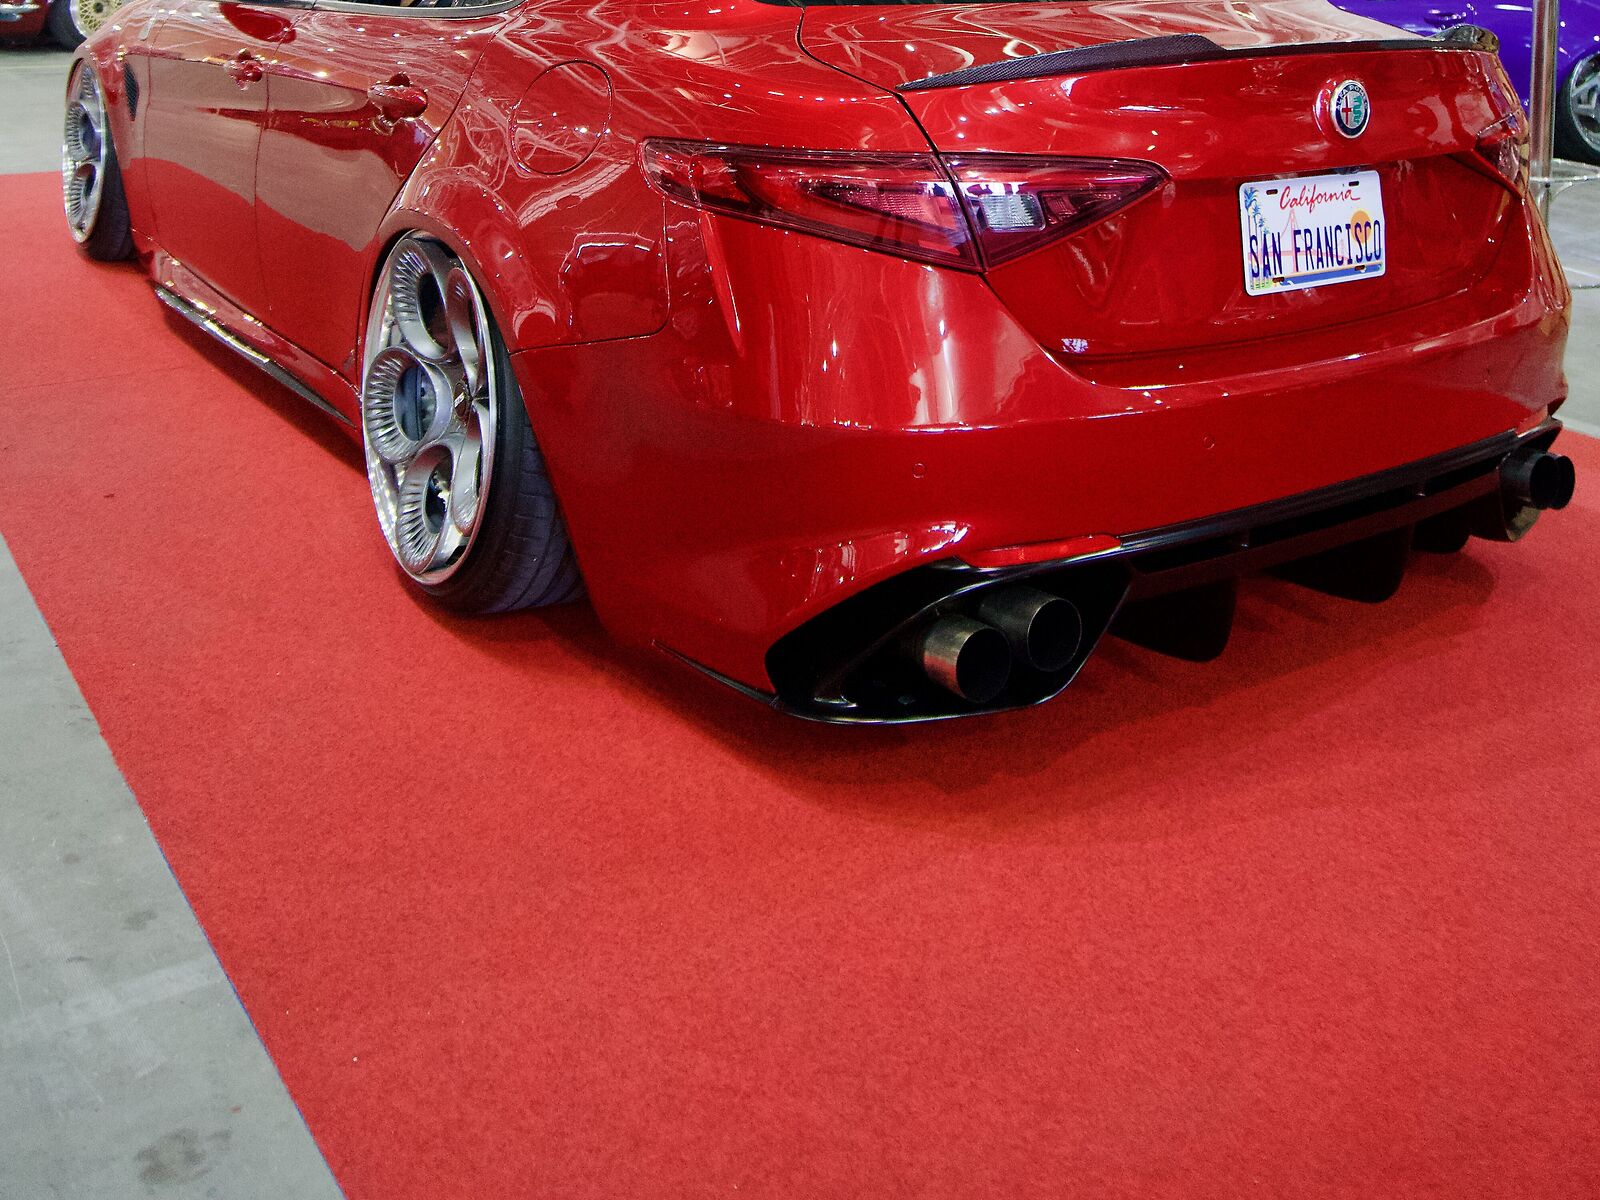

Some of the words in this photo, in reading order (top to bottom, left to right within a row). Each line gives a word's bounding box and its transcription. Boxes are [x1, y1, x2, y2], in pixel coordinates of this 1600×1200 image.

[1279, 183, 1360, 213] California
[1250, 232, 1283, 278] SAN
[1293, 219, 1382, 272] FRANCISCO
